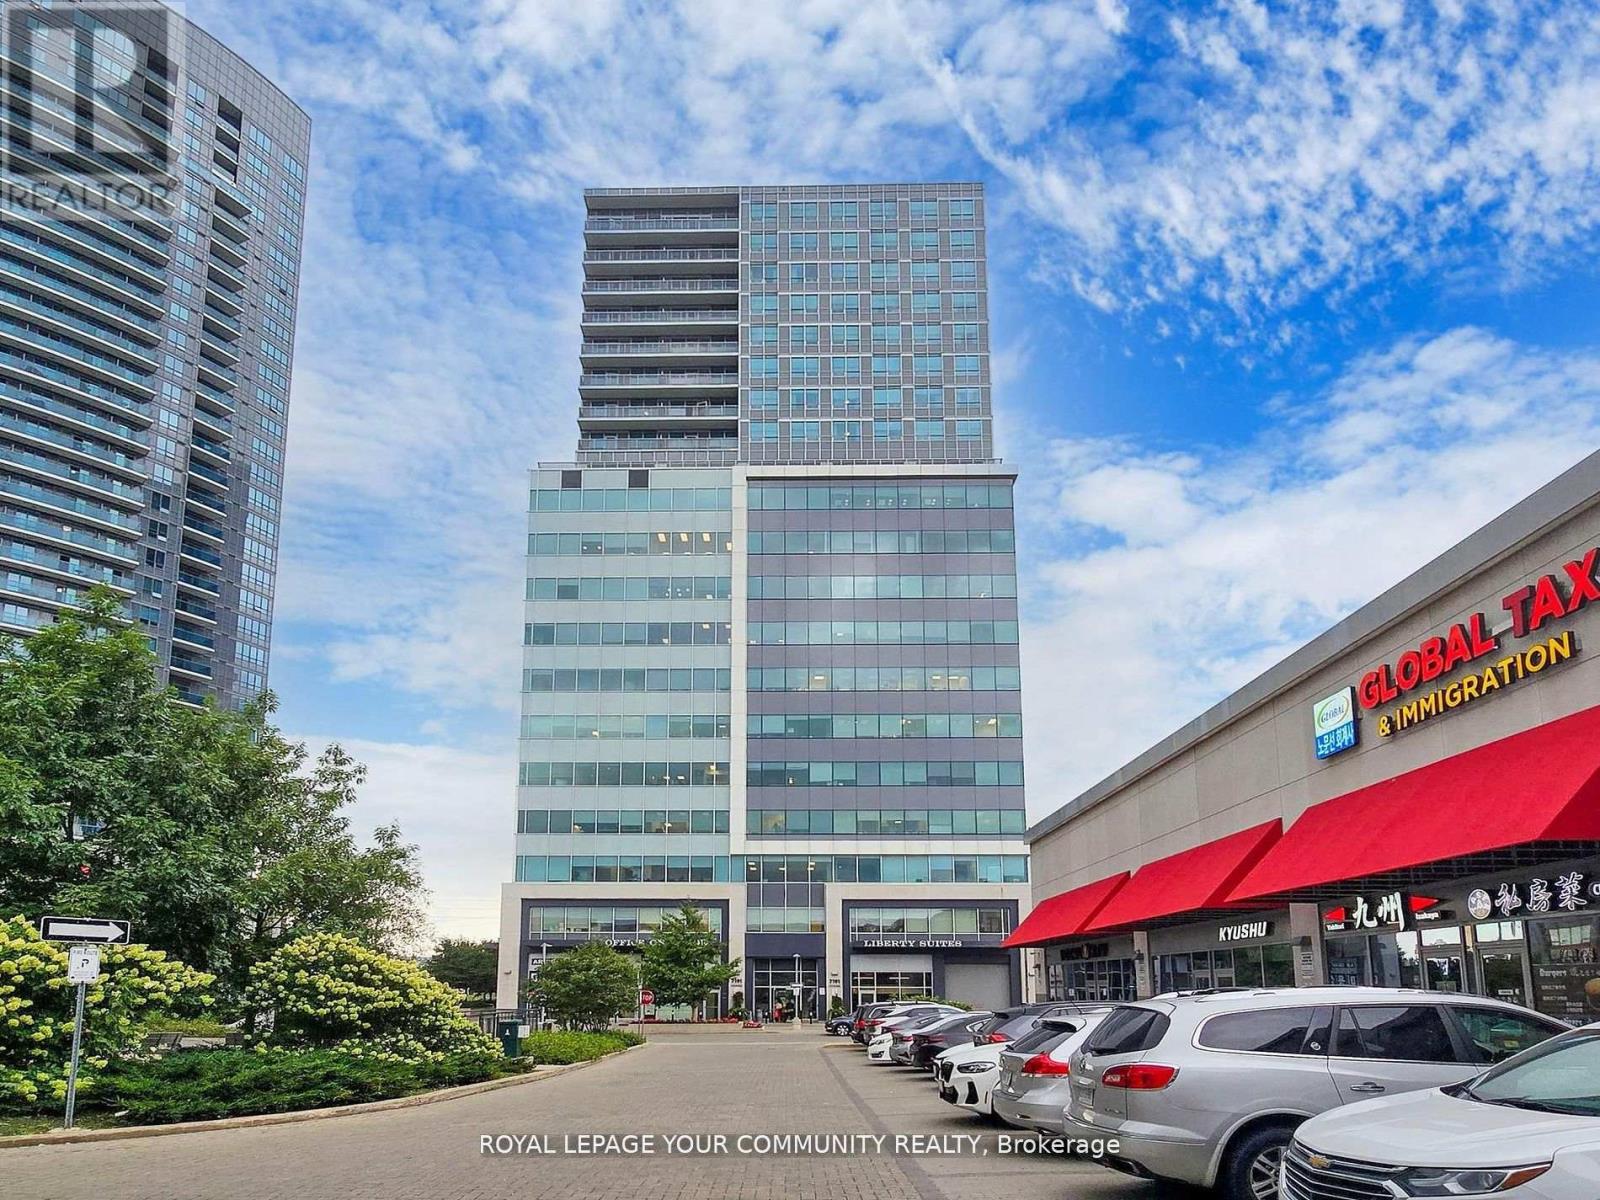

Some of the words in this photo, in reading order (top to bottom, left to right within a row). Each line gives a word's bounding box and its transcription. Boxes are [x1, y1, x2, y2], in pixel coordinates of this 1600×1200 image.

[1359, 613, 1497, 710] GLOBAL
[1502, 547, 1600, 638] TAX
[1378, 714, 1392, 738] &
[1395, 631, 1574, 732] IMMIGRATION
[1321, 703, 1345, 723] GLOBAL
[1352, 891, 1405, 932] 九州
[1495, 871, 1588, 917] 私房菜
[919, 940, 962, 948] SUITES
[1218, 921, 1268, 942] KYUSHU
